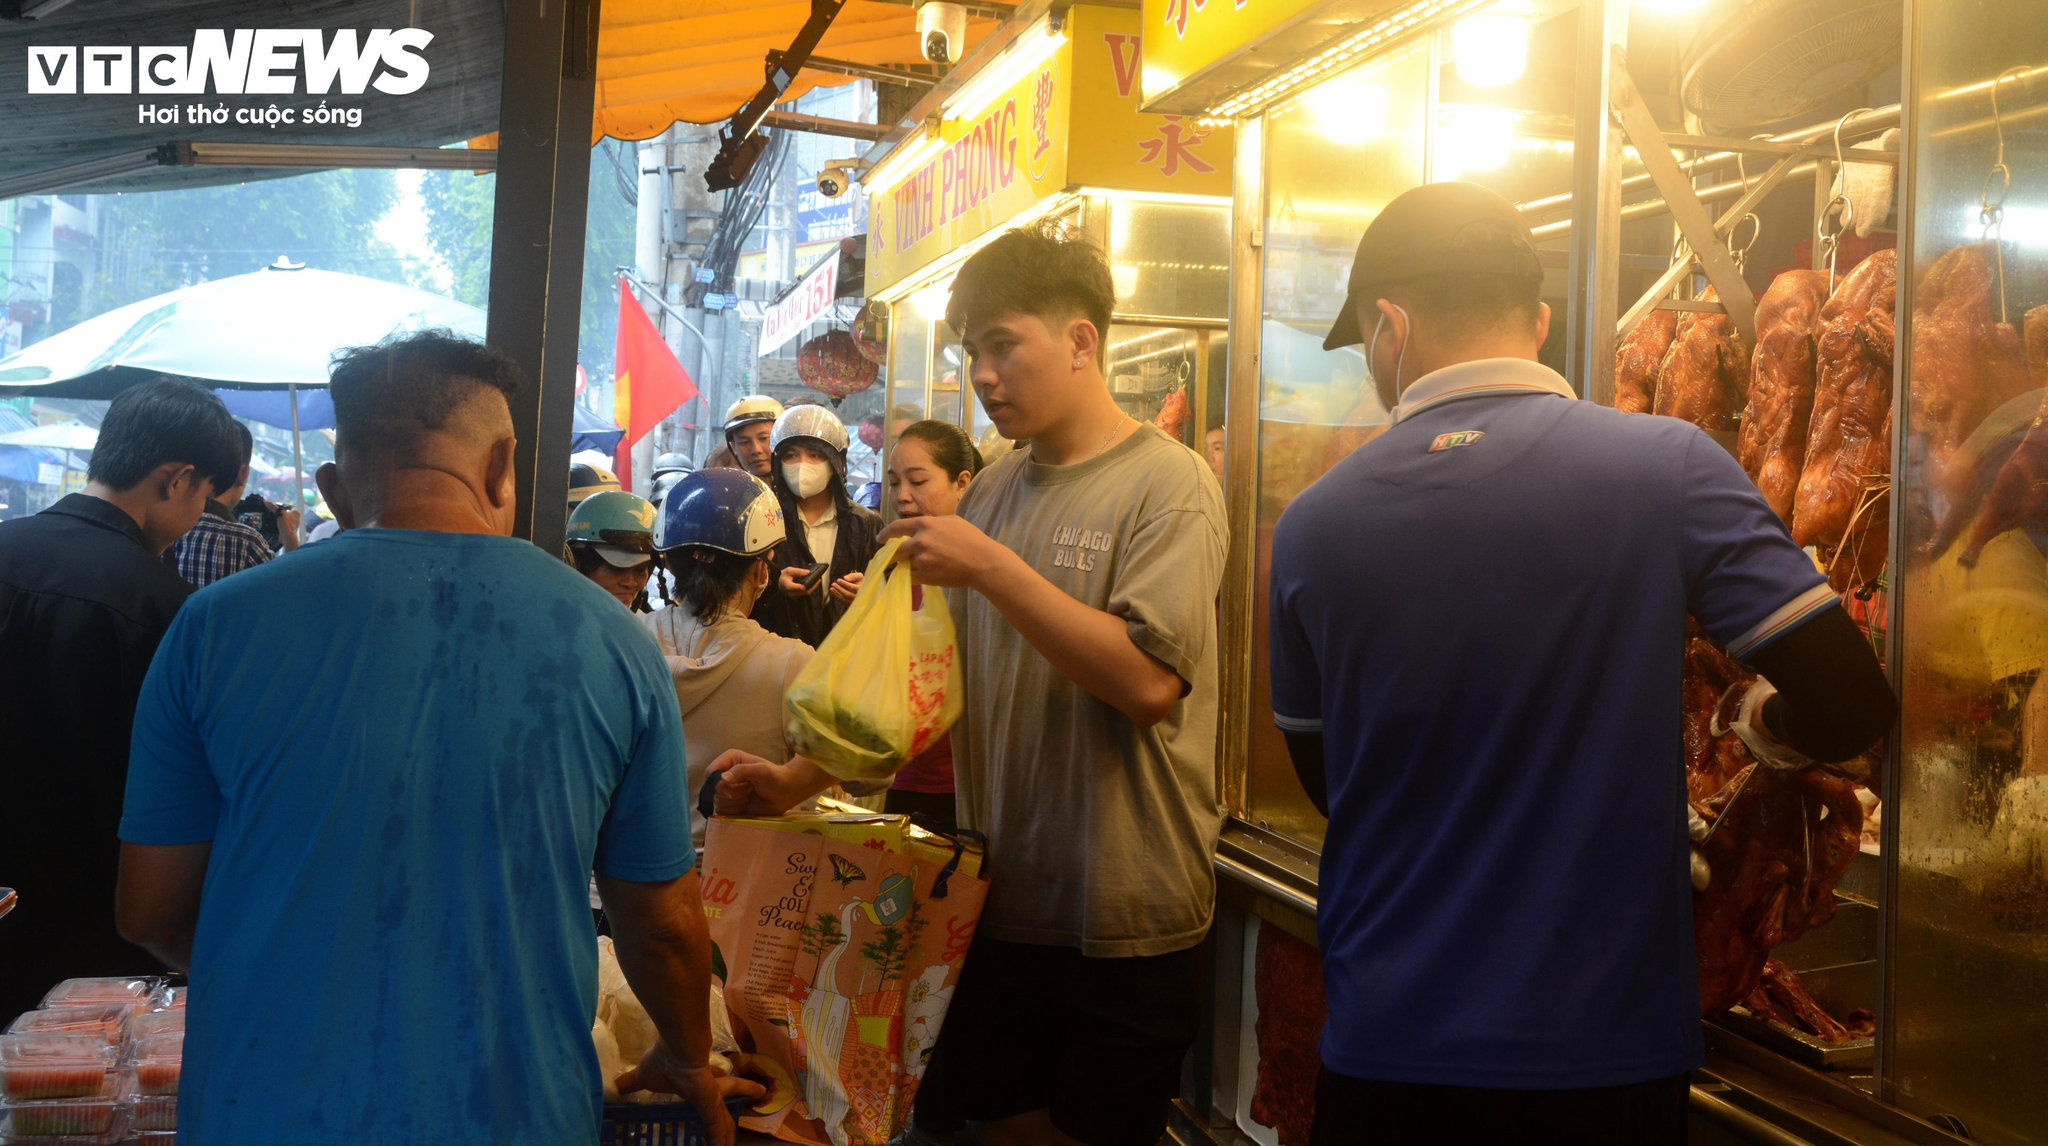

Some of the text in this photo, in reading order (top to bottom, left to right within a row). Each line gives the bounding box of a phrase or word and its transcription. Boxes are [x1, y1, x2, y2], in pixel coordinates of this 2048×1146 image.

[939, 98, 1017, 228] PHONG
[806, 265, 834, 321] 151
[1431, 431, 1484, 451] HTV
[1052, 525, 1113, 553] CHICAGO
[1053, 549, 1096, 573] BULLS
[785, 852, 817, 874] Sw
[704, 905, 723, 919] ATE
[779, 896, 808, 914] COL
[758, 905, 805, 932] Peac
